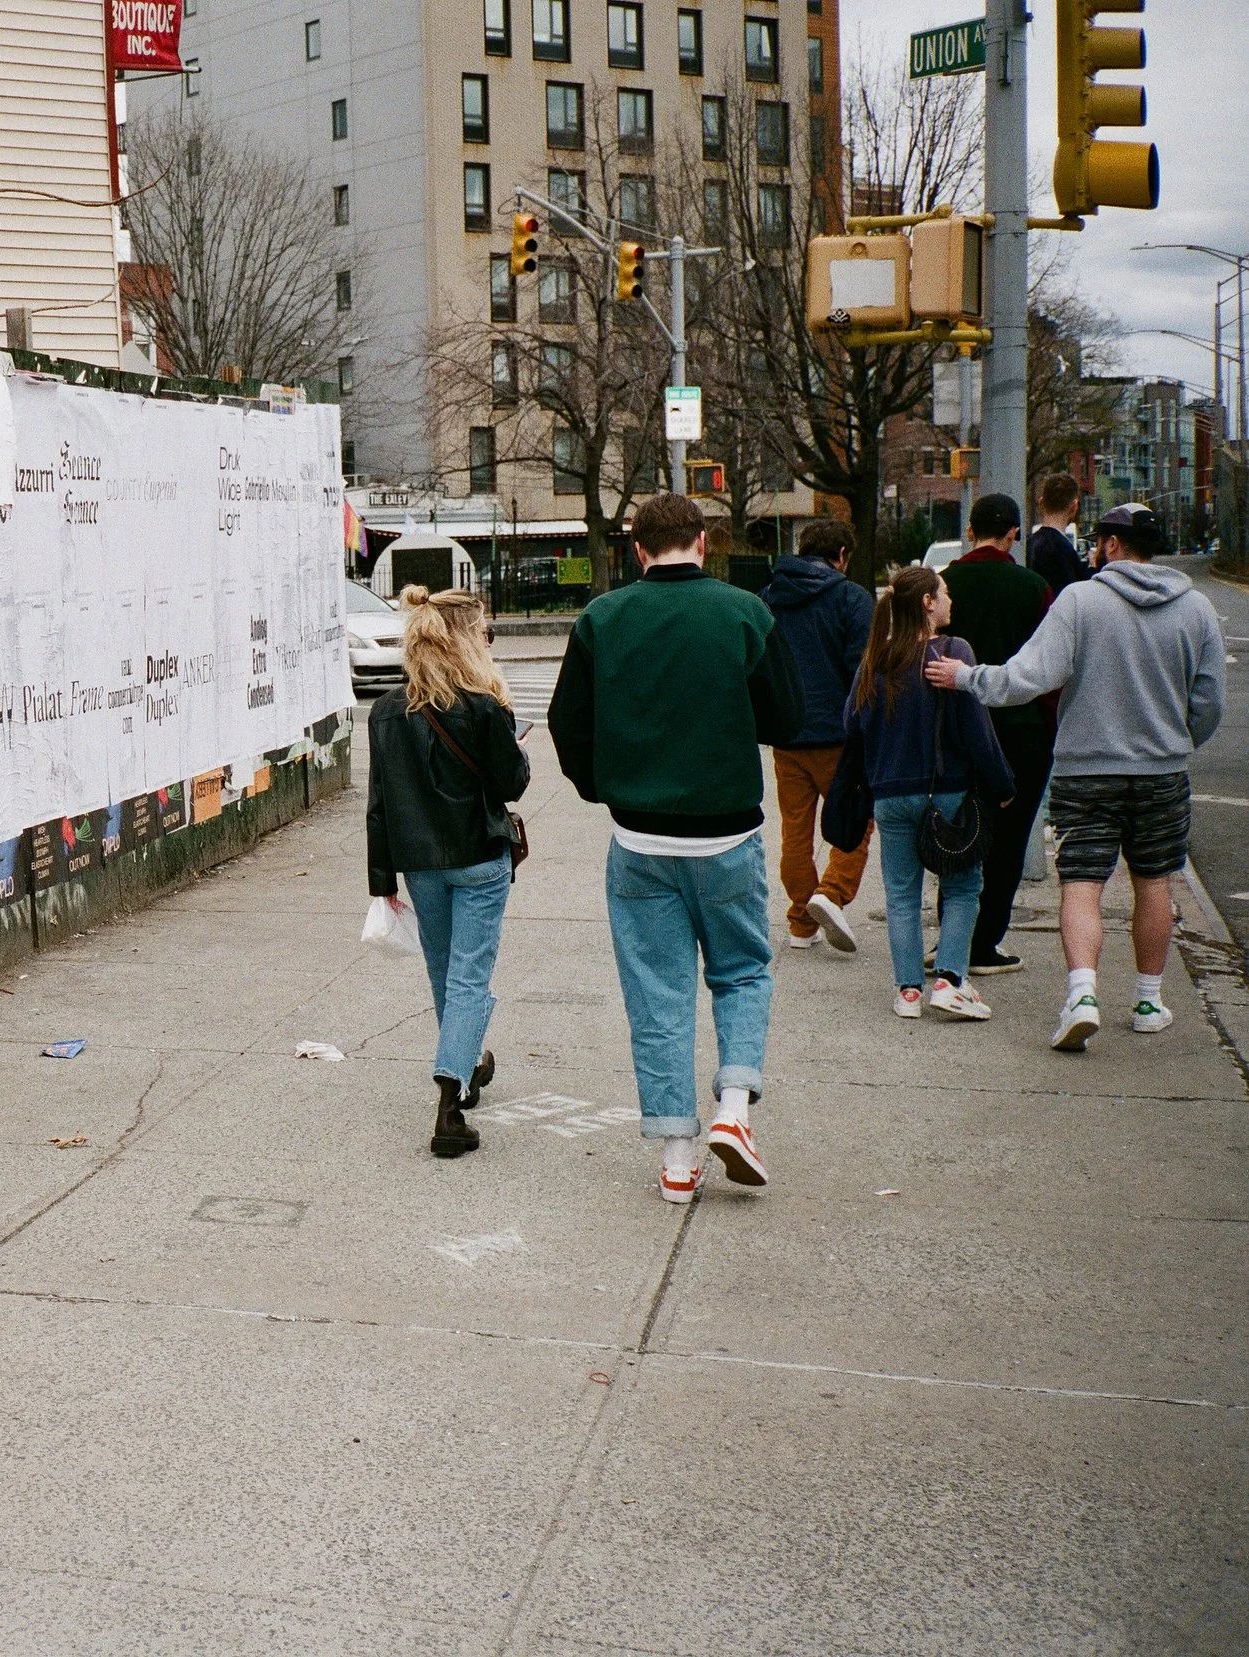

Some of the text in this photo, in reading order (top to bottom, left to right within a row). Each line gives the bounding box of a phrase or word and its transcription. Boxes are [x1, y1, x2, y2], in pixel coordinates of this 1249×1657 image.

[127, 34, 156, 56] INC.
[914, 27, 968, 73] UNION
[146, 649, 179, 688] Duplex
[23, 681, 63, 725] Pialat
[70, 680, 104, 716] Frame
[146, 689, 179, 726] Duplex
